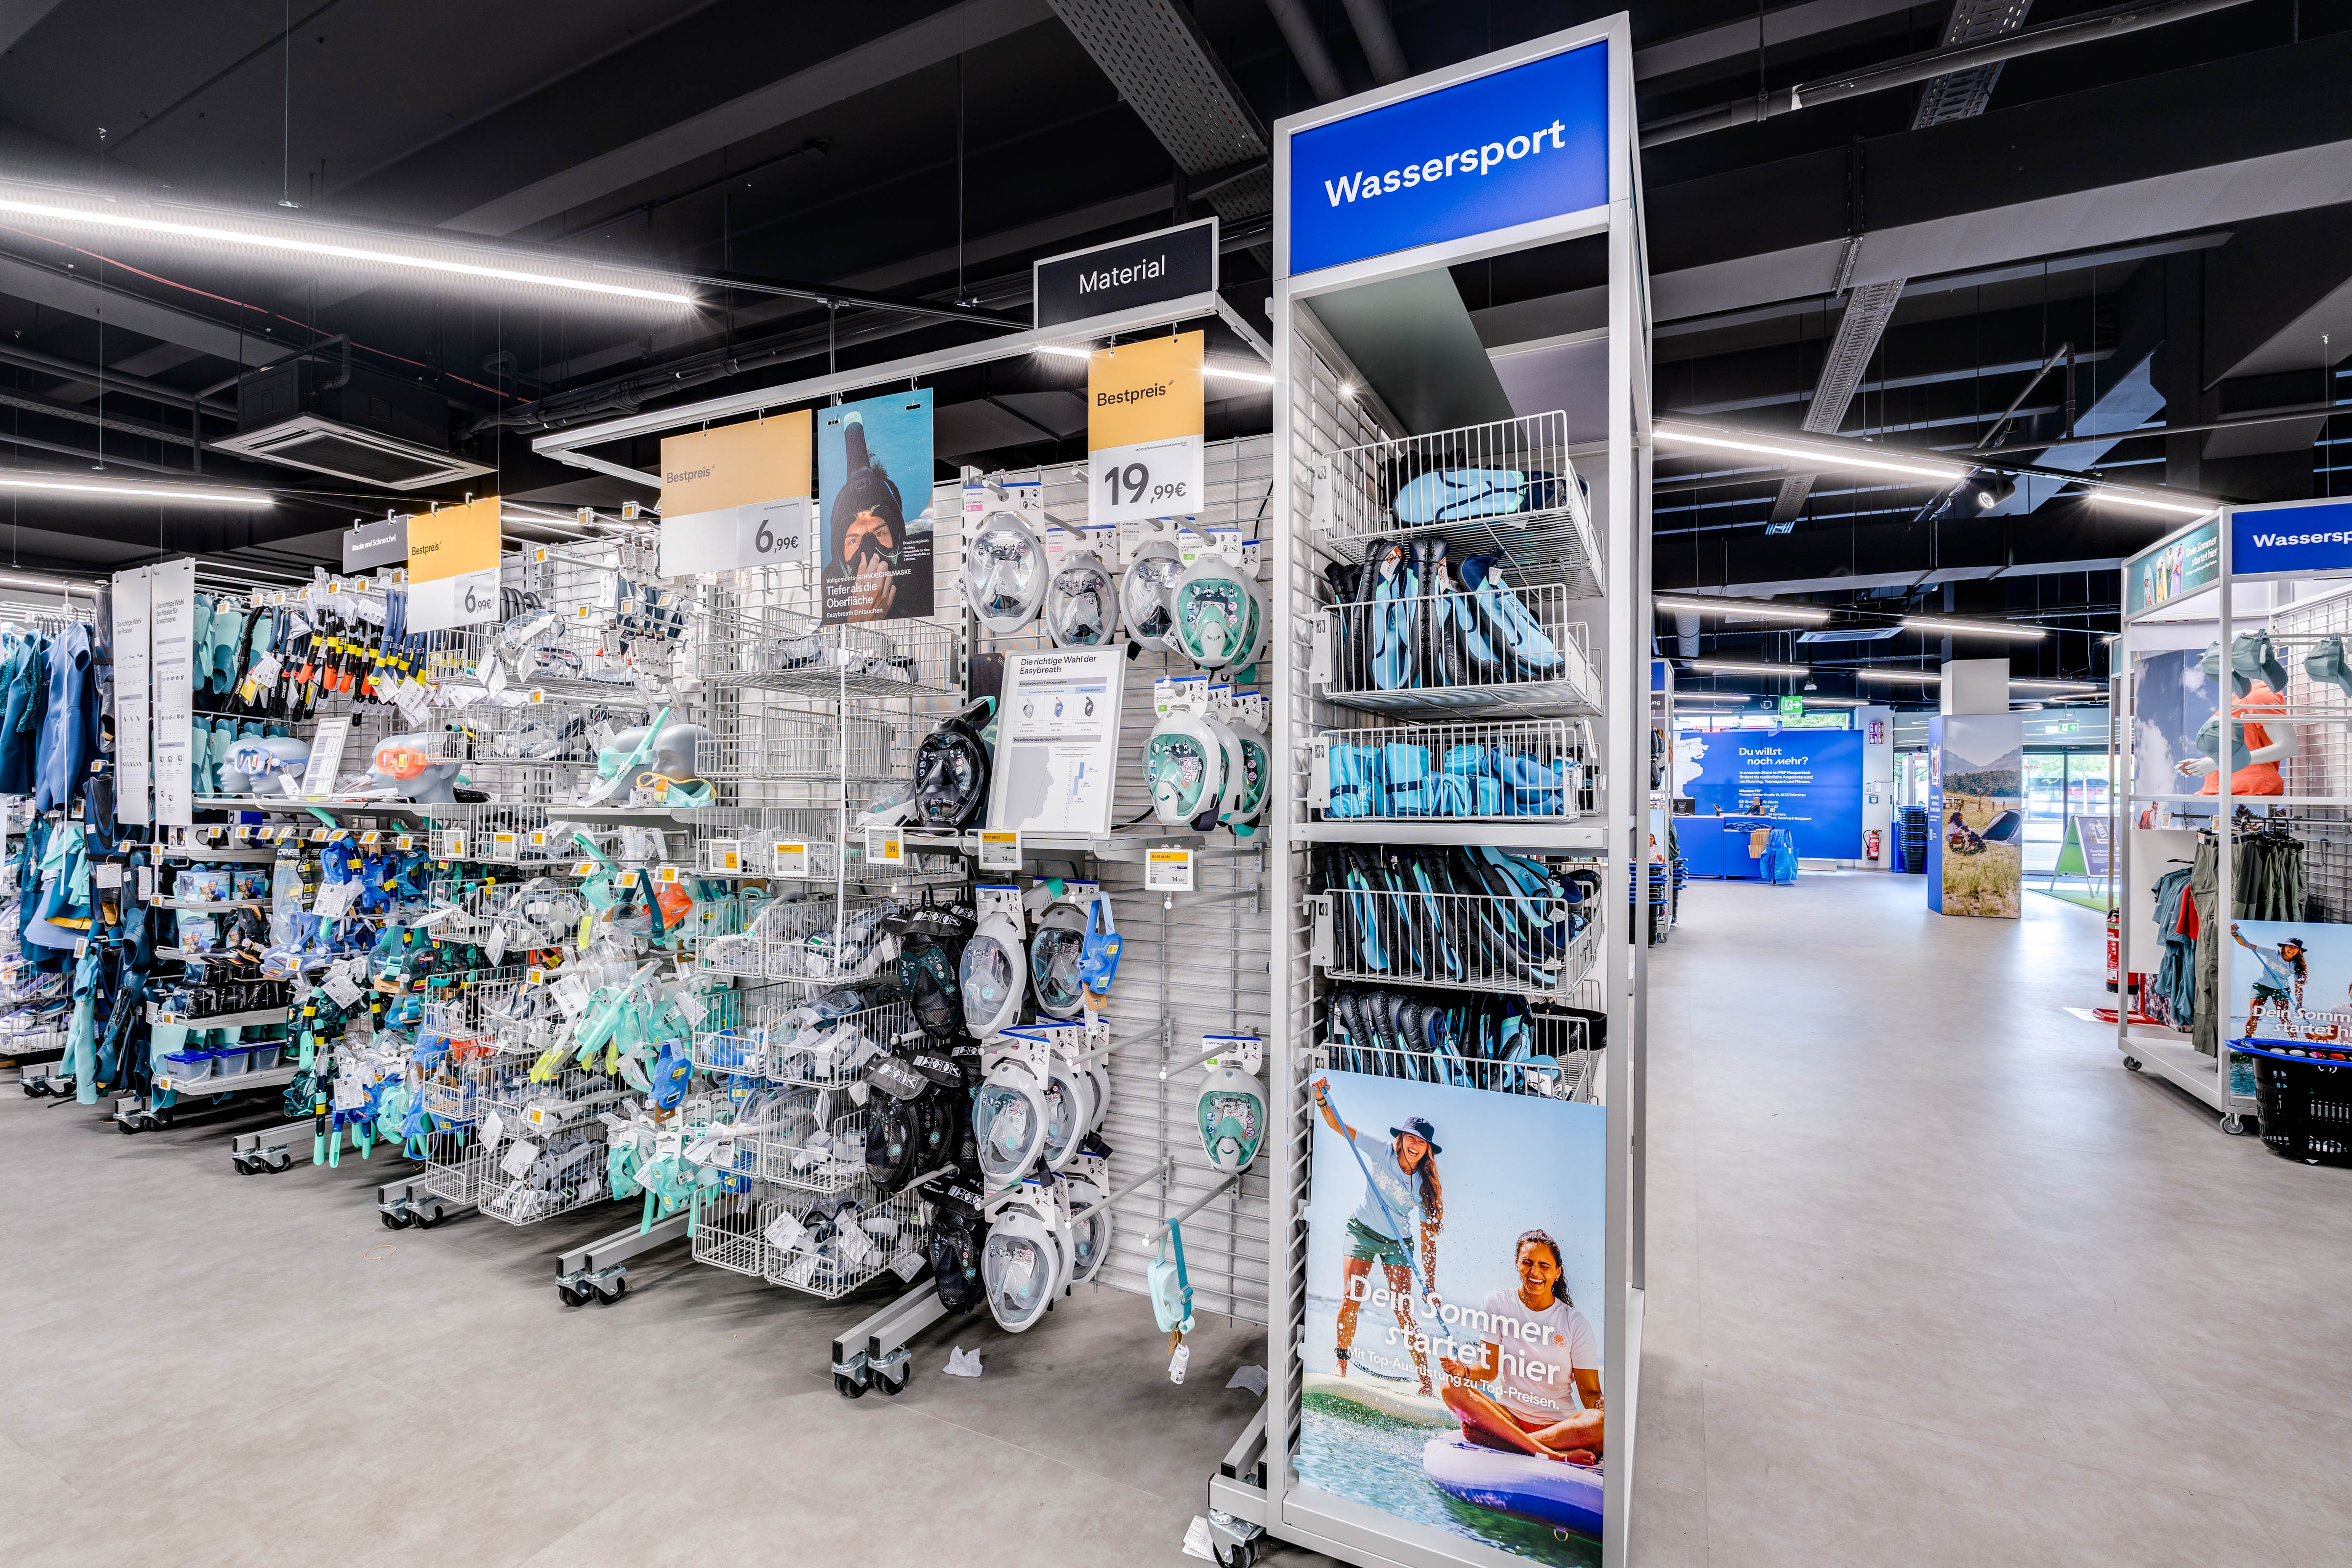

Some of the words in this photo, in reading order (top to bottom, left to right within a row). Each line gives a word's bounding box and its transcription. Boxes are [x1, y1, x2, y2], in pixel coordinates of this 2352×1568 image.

[1324, 119, 1565, 207] Wassersport
[1080, 255, 1165, 294] Material
[1097, 383, 1166, 406] Bestpreis
[666, 466, 710, 484] Bestpreis
[1104, 463, 1186, 505] 19,99€
[352, 540, 365, 552] Maske
[364, 539, 372, 548] und
[372, 534, 396, 547] Schnorchel
[755, 519, 799, 554] 6,99€
[412, 542, 440, 556] Bestpreis
[2186, 545, 2197, 558] Dein
[2197, 536, 2217, 552] Sommer
[2191, 552, 2207, 566] startet
[2208, 548, 2218, 559] hier
[826, 569, 912, 584] Vollgesichts-SCHNORCHELMASKE
[826, 585, 850, 596] Tiefer
[851, 584, 862, 593] als
[864, 582, 877, 592] die
[161, 600, 174, 609] richtige
[465, 586, 492, 613] 6,99€
[827, 595, 873, 608] Oberfläche
[156, 616, 176, 625] Erwachsene
[827, 610, 853, 618] Easybreath
[854, 608, 883, 616] Eintauchen
[1034, 657, 1062, 665] richtige
[1020, 665, 1061, 675] Easybreath
[235, 678, 244, 694] CRESSI
[1739, 747, 1753, 756] Du
[1755, 747, 1782, 756] willst
[1747, 757, 1773, 765] noch
[2253, 1005, 2291, 1018] Dein
[2274, 1021, 2334, 1036] startet
[2338, 1025, 2352, 1038] hi
[1349, 1274, 1415, 1315] Dein
[1421, 1292, 1557, 1346] Sommer
[1385, 1323, 1491, 1370] startet
[1498, 1344, 1561, 1385] hier
[1347, 1346, 1366, 1362] Mit
[1368, 1350, 1461, 1387] Top-Ausrüstung
[1462, 1376, 1478, 1388] zu
[1481, 1379, 1560, 1410] Top-Preisen.
